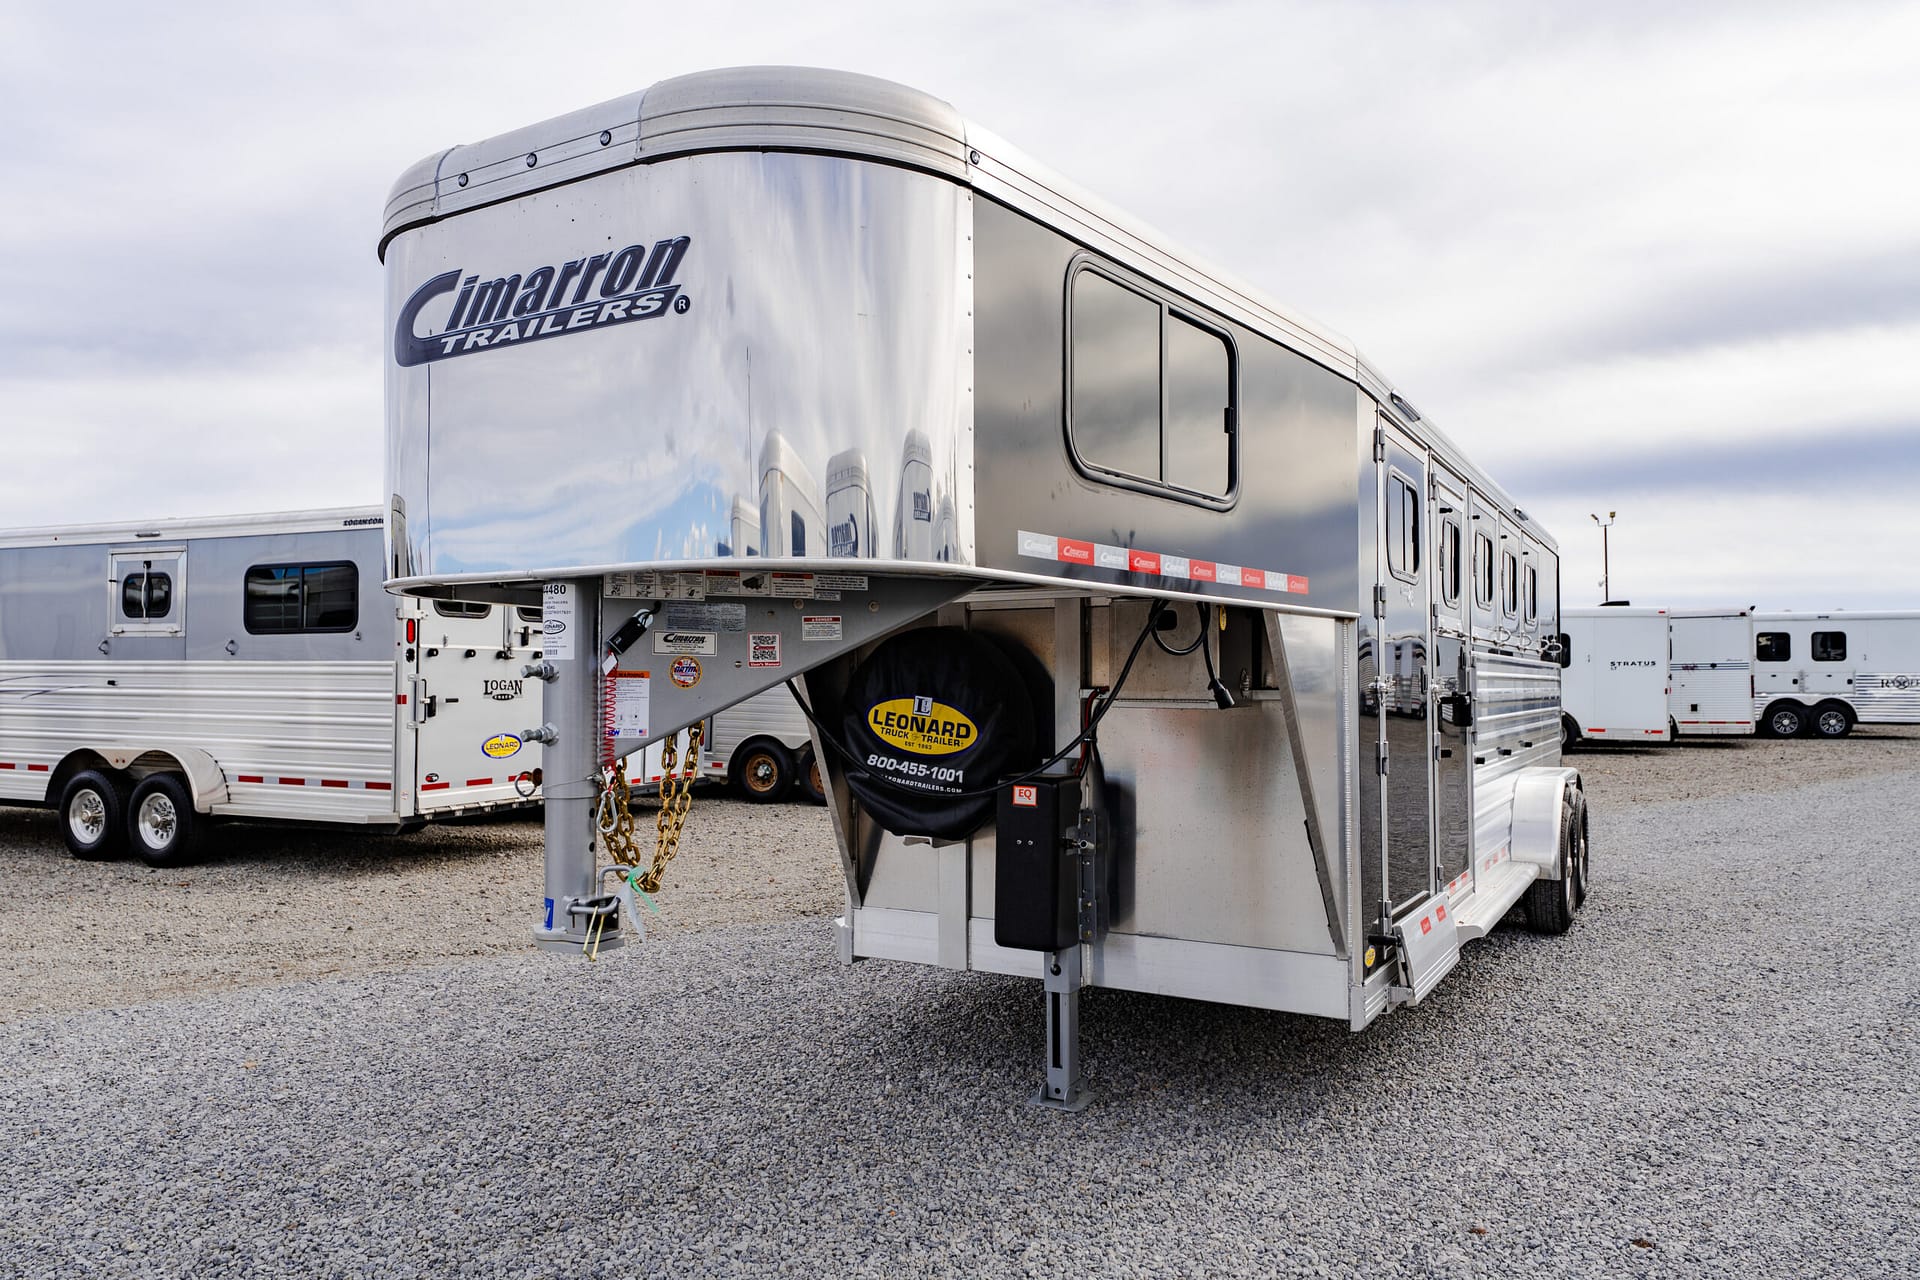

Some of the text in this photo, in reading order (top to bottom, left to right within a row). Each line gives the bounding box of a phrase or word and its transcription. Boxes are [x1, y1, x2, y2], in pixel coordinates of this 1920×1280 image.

[394, 235, 691, 367] Cimarron
[440, 293, 666, 355] TRAILERS
[483, 679, 523, 695] LOGAN
[873, 709, 971, 739] LEONARD
[880, 727, 909, 739] TRUCK
[921, 734, 960, 747] TRAILER
[866, 754, 964, 783] 800-455-1001
[1018, 788, 1032, 799] EQ
